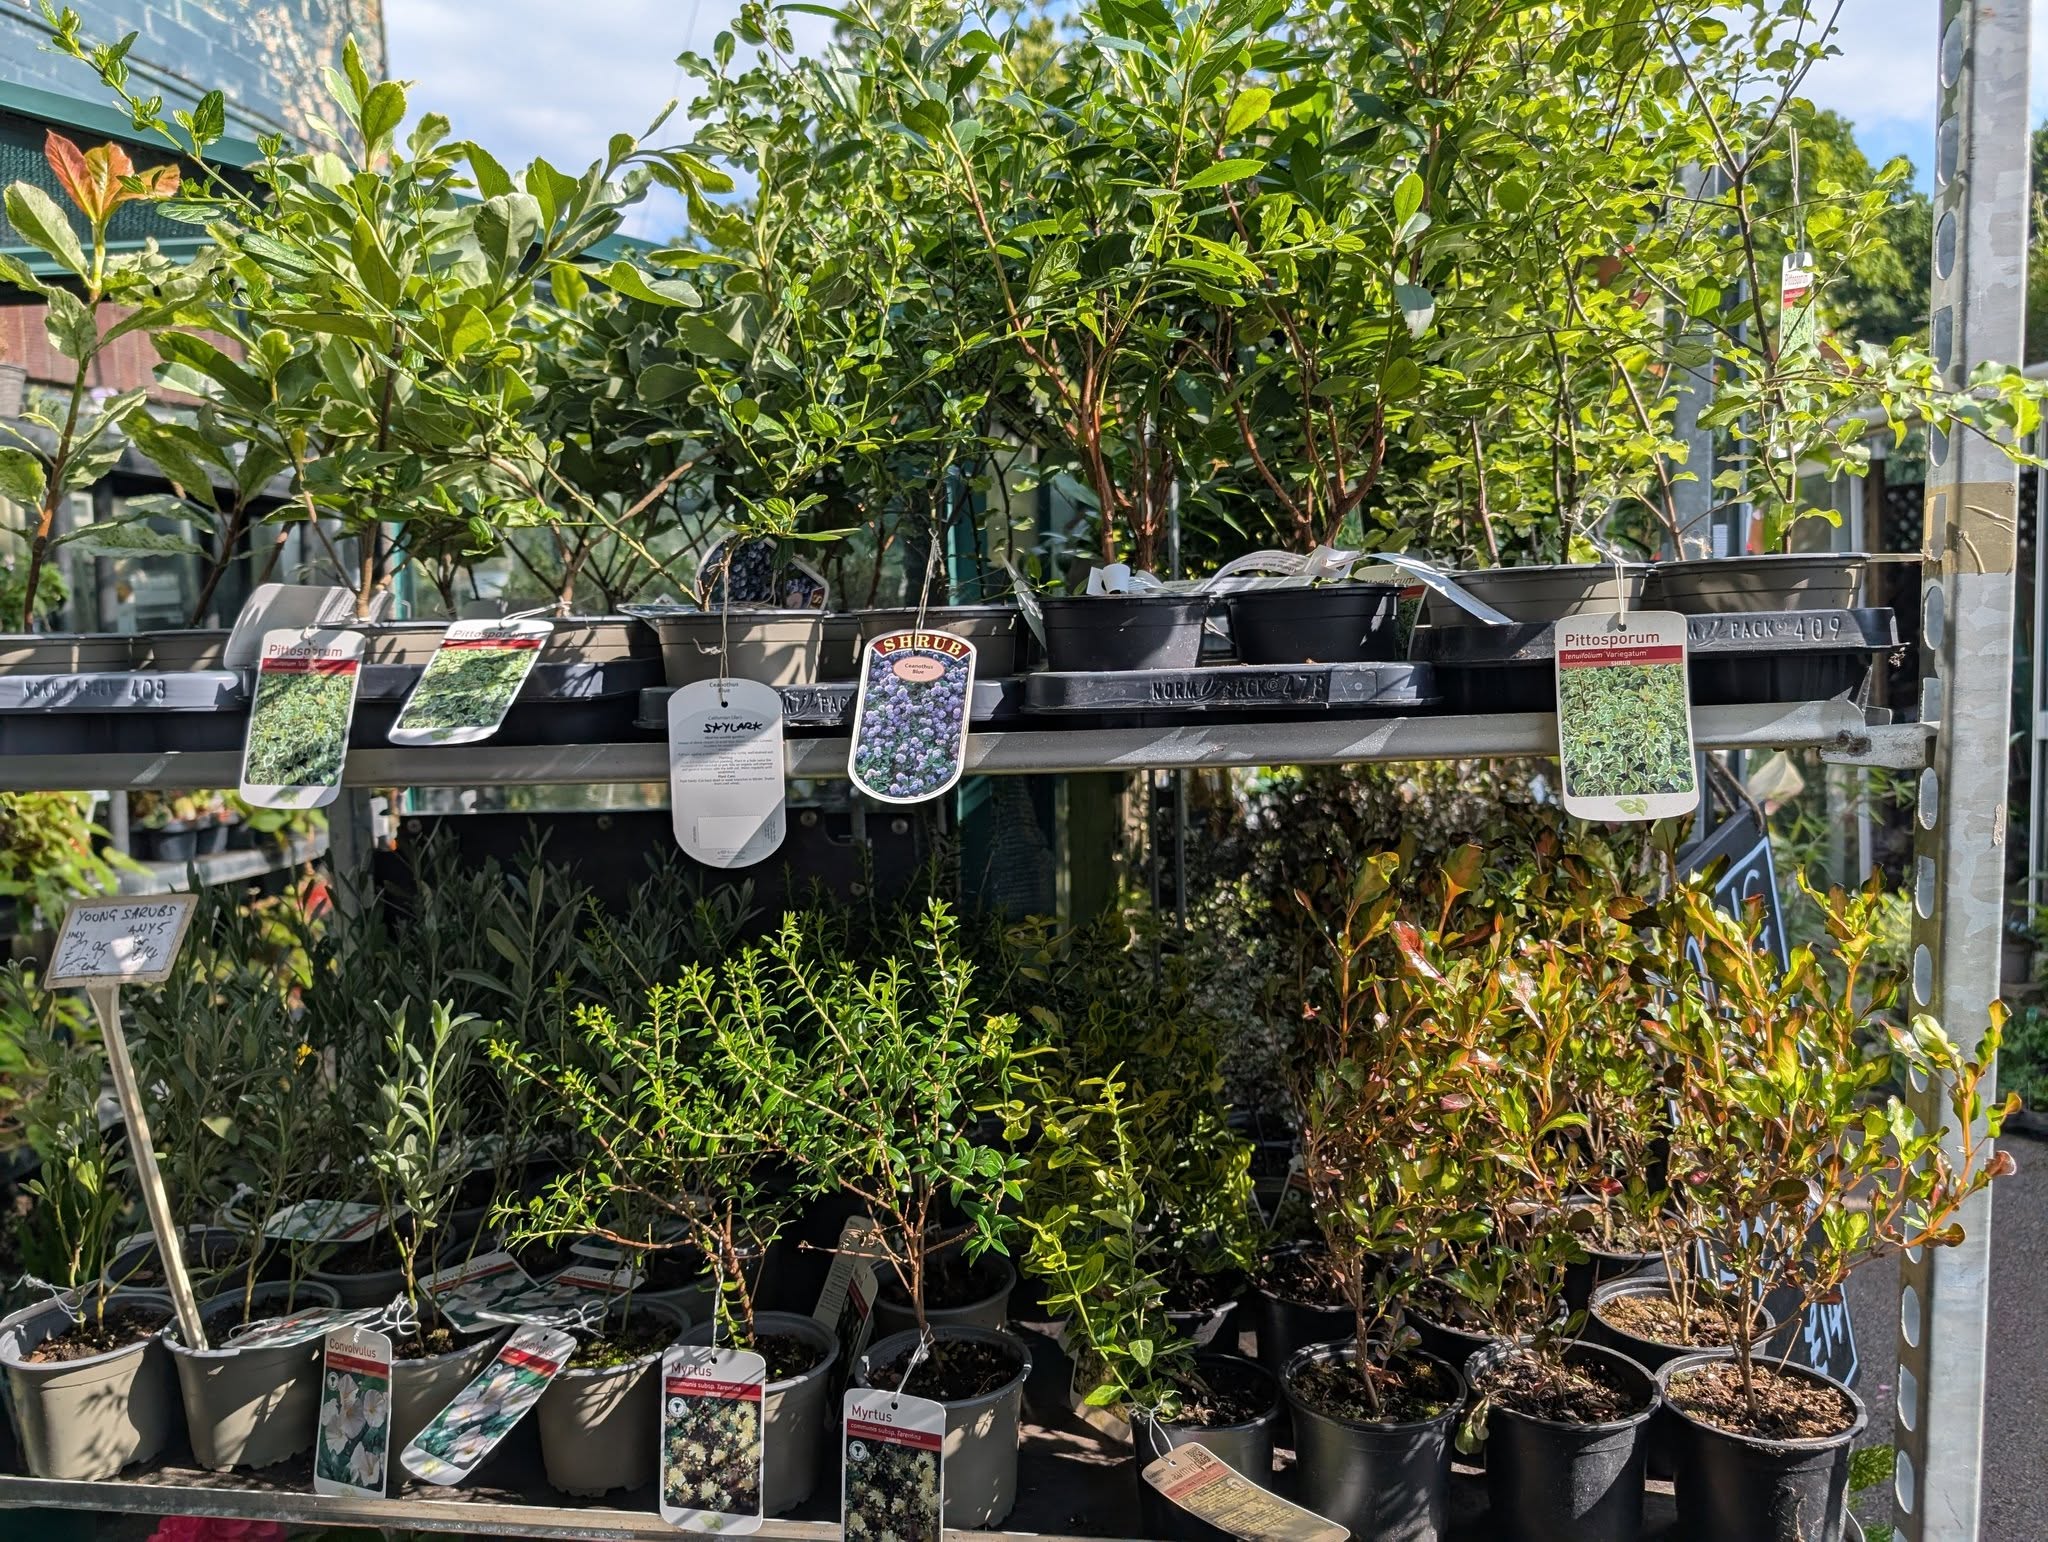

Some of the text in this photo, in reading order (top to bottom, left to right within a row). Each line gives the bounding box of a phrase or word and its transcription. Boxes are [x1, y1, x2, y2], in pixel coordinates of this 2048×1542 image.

[1793, 615, 1842, 642] 409
[883, 634, 962, 656] SHRUB
[1565, 632, 1660, 649] Pittosporum
[127, 678, 167, 703] 408
[703, 721, 763, 734] SKYLARK
[329, 1337, 377, 1359] Convolvulus
[671, 1361, 712, 1377] Myrtus
[851, 1404, 893, 1422] Myrtus
